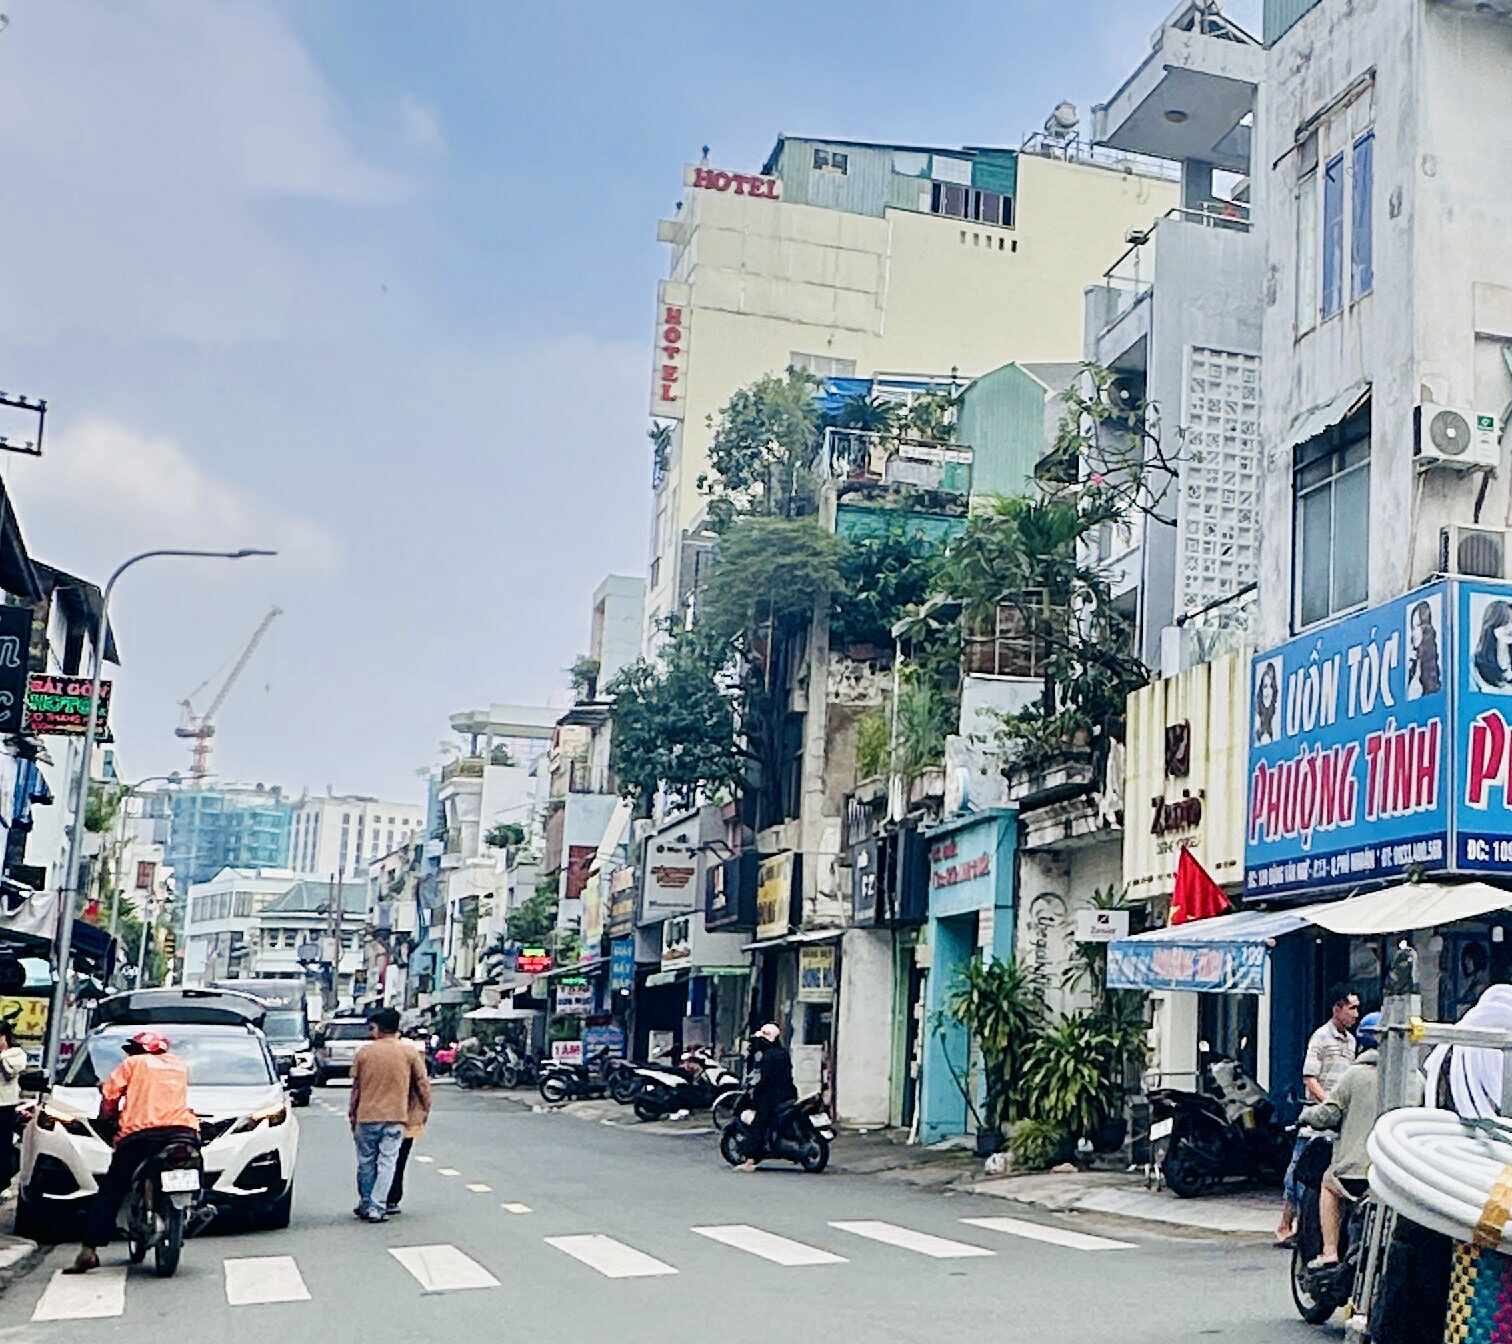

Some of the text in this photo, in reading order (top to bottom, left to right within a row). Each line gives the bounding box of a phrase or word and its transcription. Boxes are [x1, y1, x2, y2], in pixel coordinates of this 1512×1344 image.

[693, 167, 780, 200] HOTEL
[661, 307, 682, 402] HOTEL
[1287, 625, 1400, 736] UỐN TÓC
[1250, 716, 1442, 850] PHƯỢNG TÍNH
